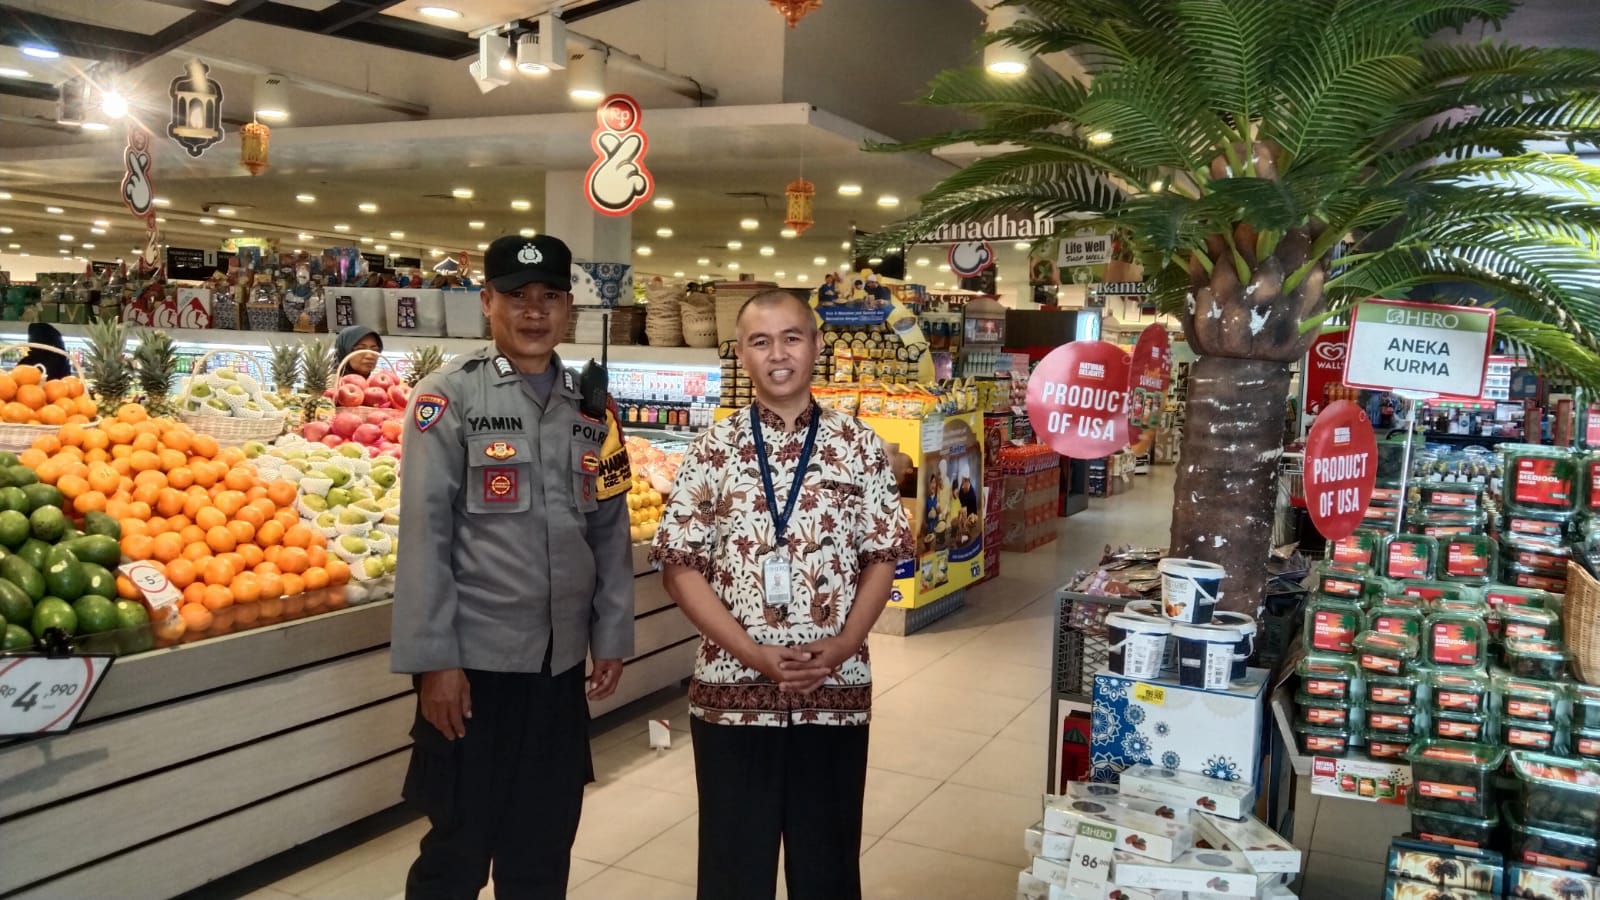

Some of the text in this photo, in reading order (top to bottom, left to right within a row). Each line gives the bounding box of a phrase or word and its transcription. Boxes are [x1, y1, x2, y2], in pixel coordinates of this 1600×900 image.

[908, 212, 1054, 241] amadhan
[1065, 240, 1106, 255] Life Well
[1405, 311, 1460, 329] HERO
[1388, 337, 1451, 357] ANEKA
[1316, 360, 1345, 370] WALL'
[1383, 357, 1450, 377] KURMA
[1041, 381, 1130, 415] PRODUCT
[467, 416, 524, 432] YAMIN
[1047, 411, 1115, 441] OF USA
[572, 423, 607, 446] POLR
[1313, 452, 1369, 485] PRODUCT
[1320, 487, 1360, 518] OF USA
[144, 574, 156, 585] 5
[0, 684, 17, 698] Rp
[1090, 826, 1113, 840] HERO
